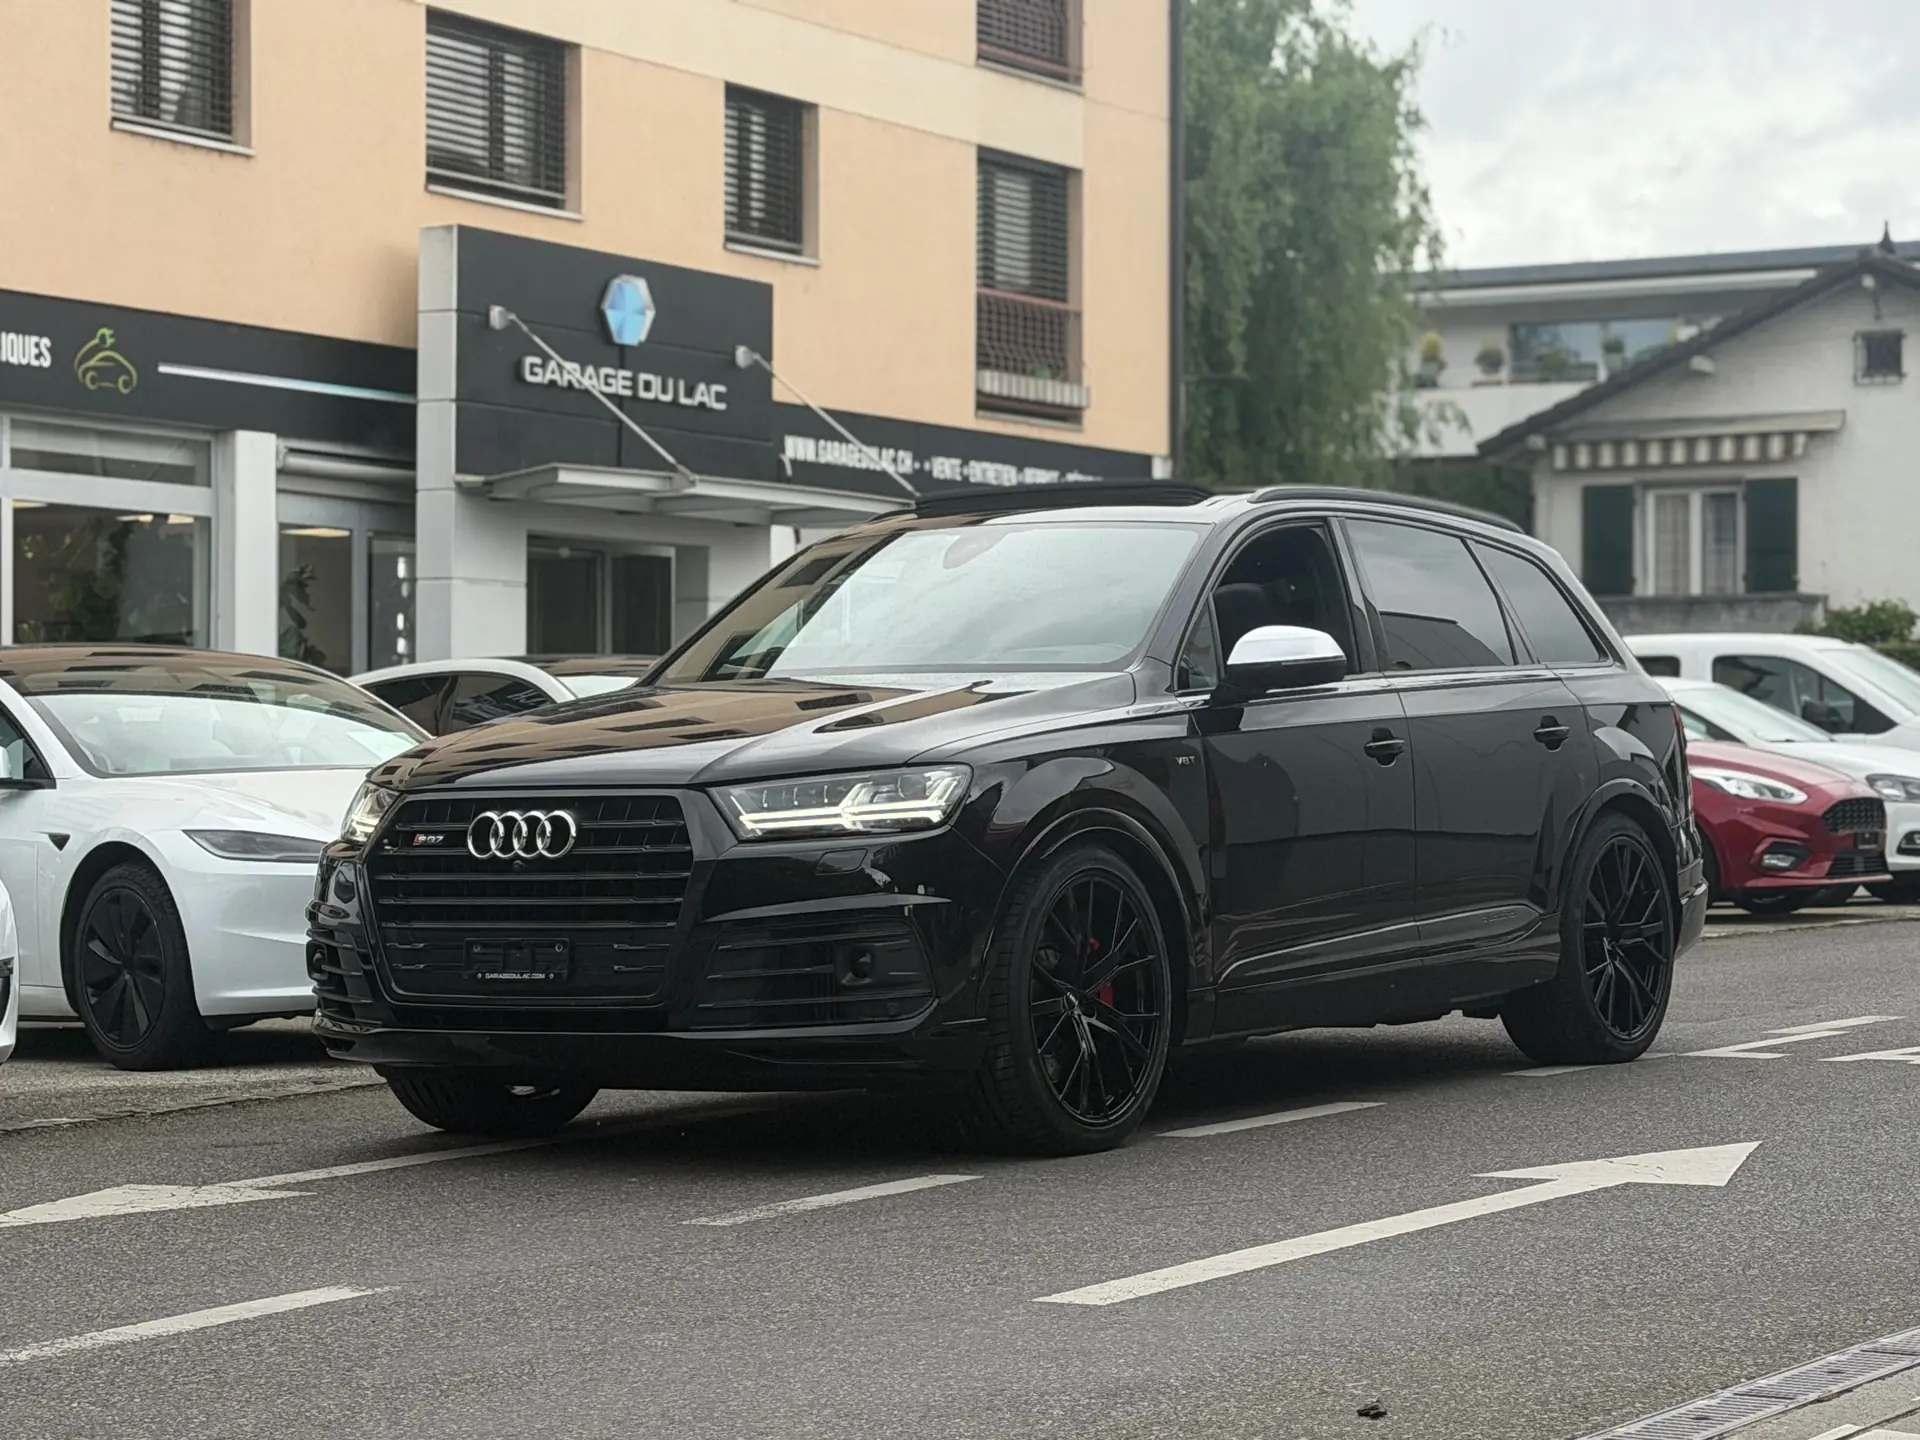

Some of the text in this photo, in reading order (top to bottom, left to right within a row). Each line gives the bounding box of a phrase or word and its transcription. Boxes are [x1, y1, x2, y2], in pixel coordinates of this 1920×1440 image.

[0, 331, 52, 368] IQUES
[524, 355, 728, 410] GARAGE DU LAC
